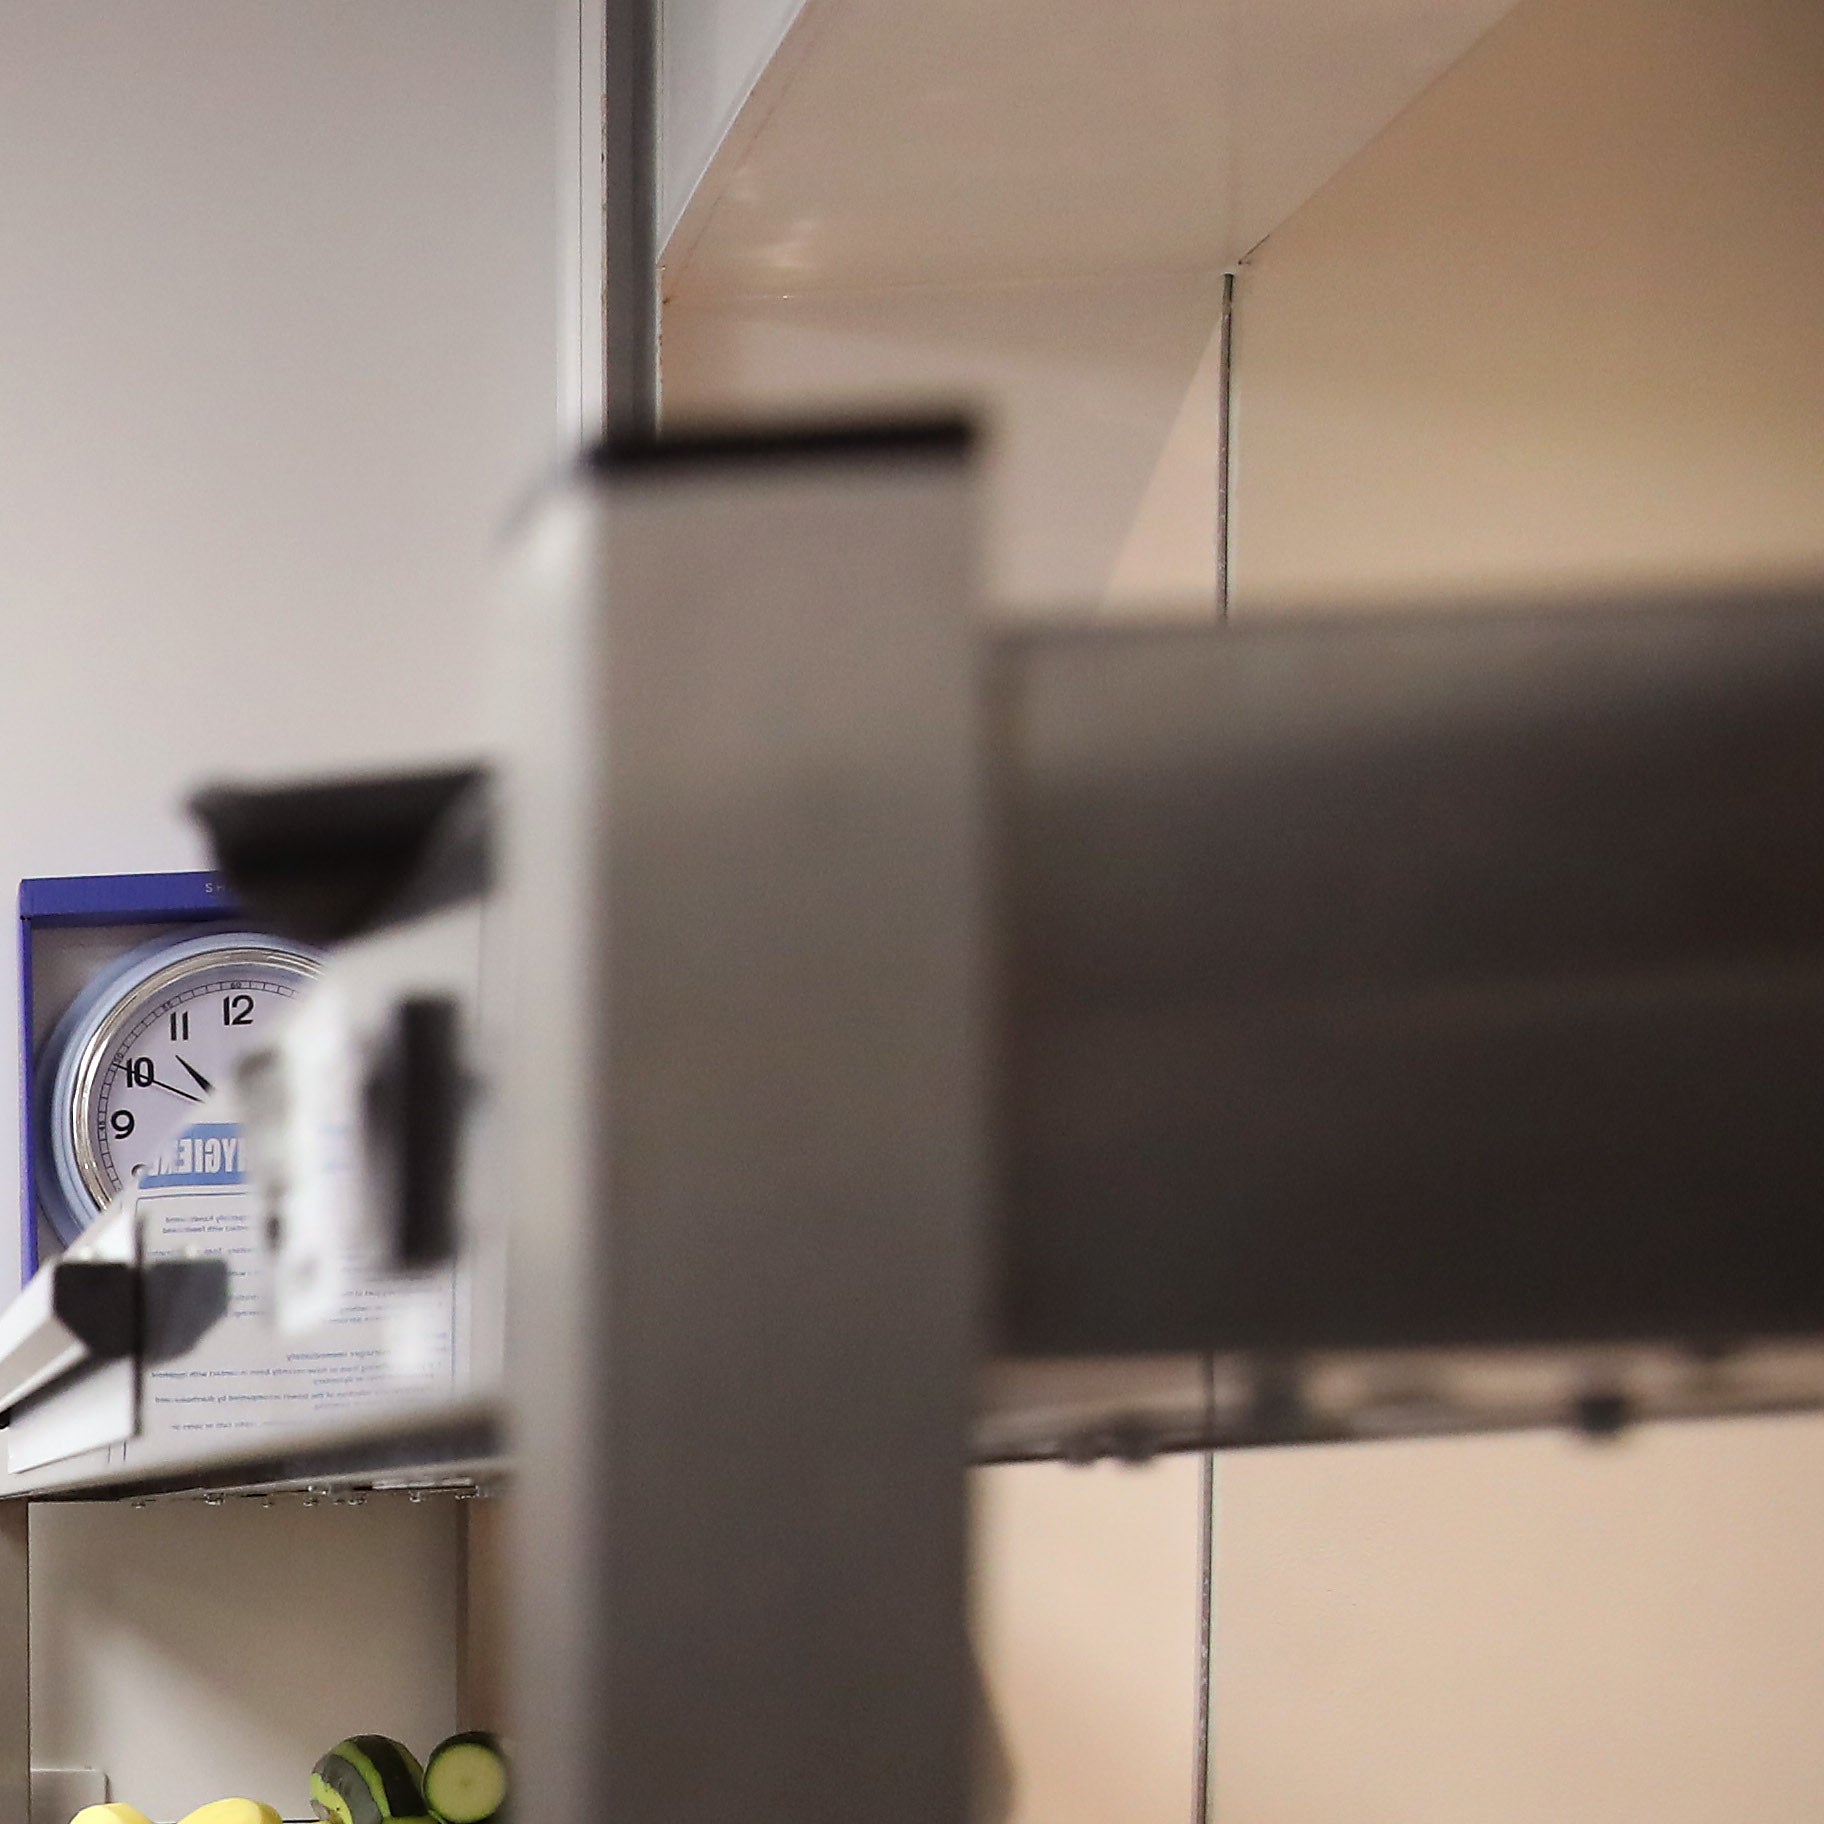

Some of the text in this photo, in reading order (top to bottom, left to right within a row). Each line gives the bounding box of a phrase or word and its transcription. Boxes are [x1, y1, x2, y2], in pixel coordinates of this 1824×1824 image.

[170, 1010, 189, 1041] 11
[222, 994, 254, 1026] 12
[126, 1056, 155, 1088] 10
[110, 1109, 135, 1140] 9
